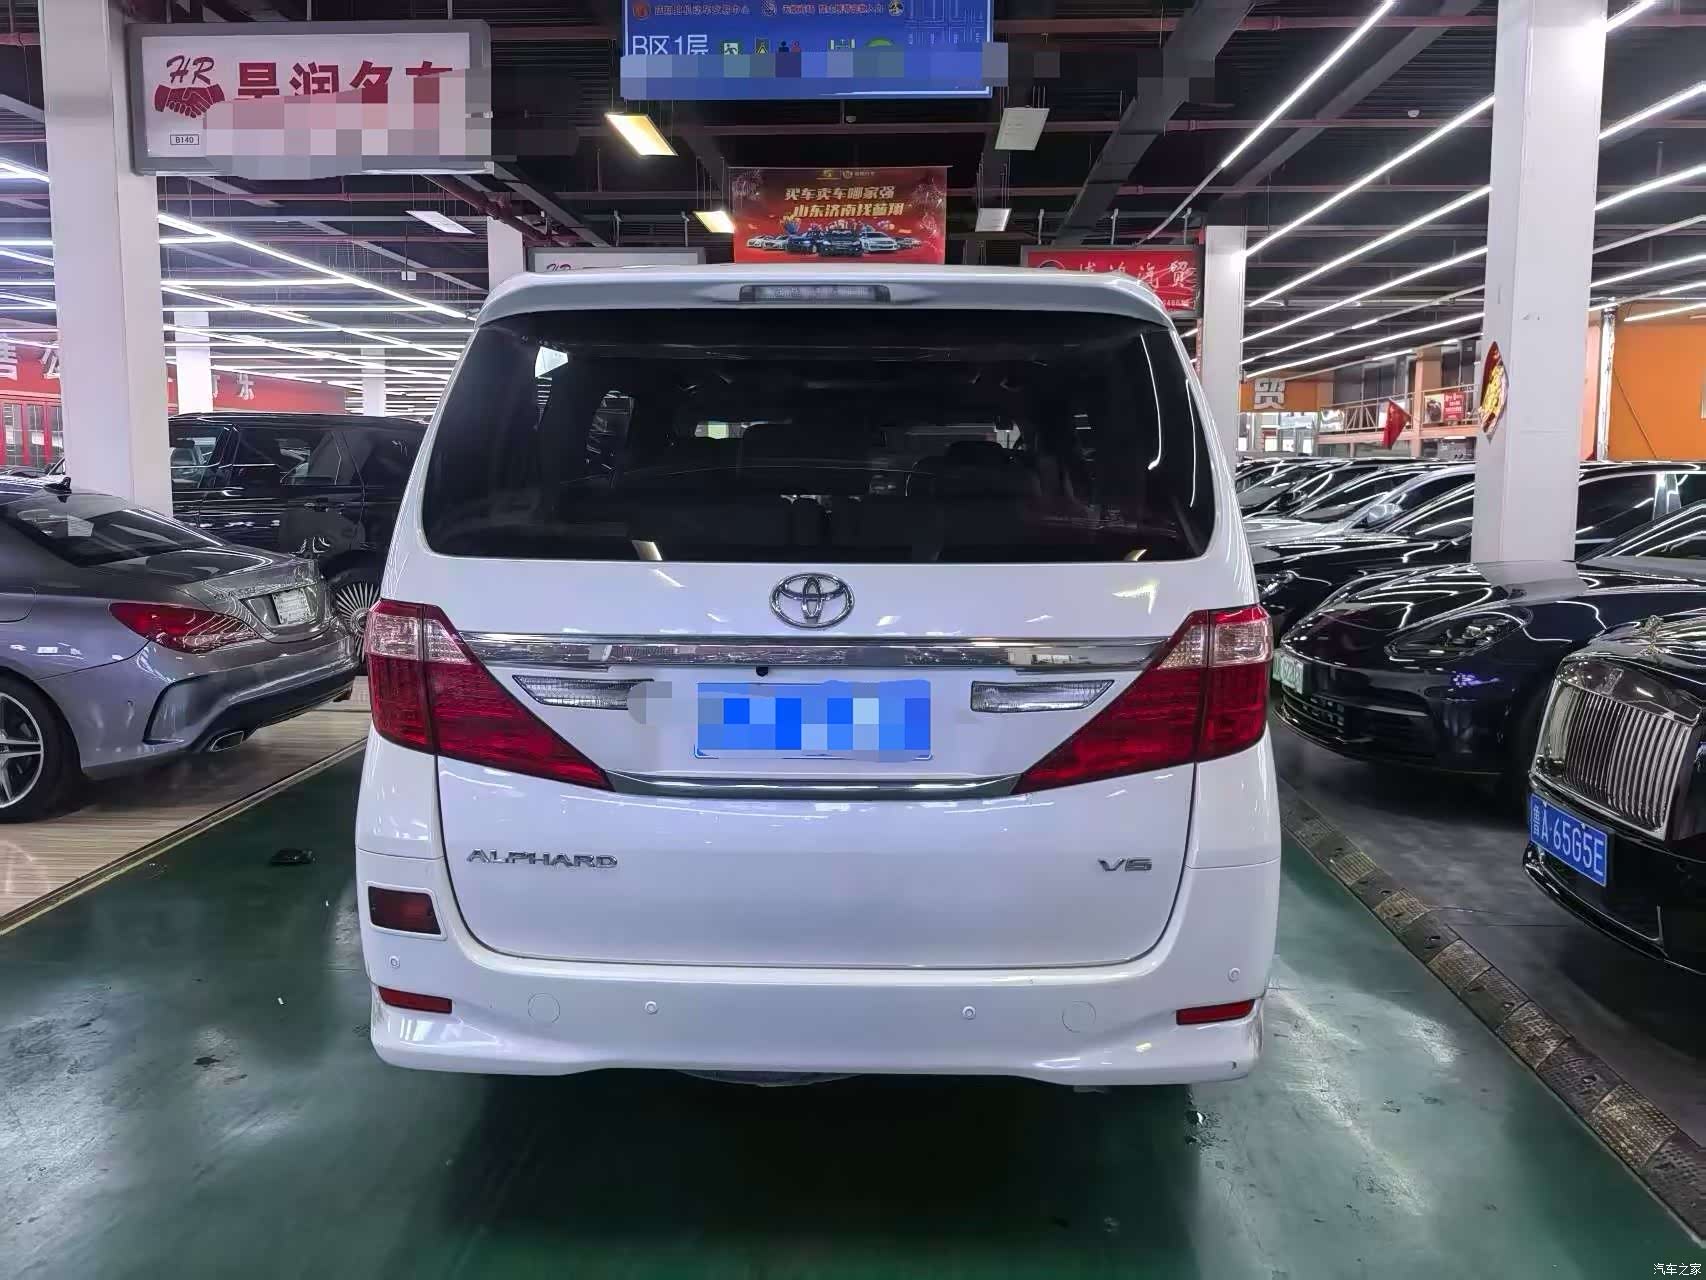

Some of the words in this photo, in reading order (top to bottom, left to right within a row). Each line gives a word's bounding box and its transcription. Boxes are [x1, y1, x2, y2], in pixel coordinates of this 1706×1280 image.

[166, 55, 215, 85] HR
[175, 136, 194, 144] B140
[467, 849, 618, 868] ALPHARD
[1098, 857, 1153, 872] V6
